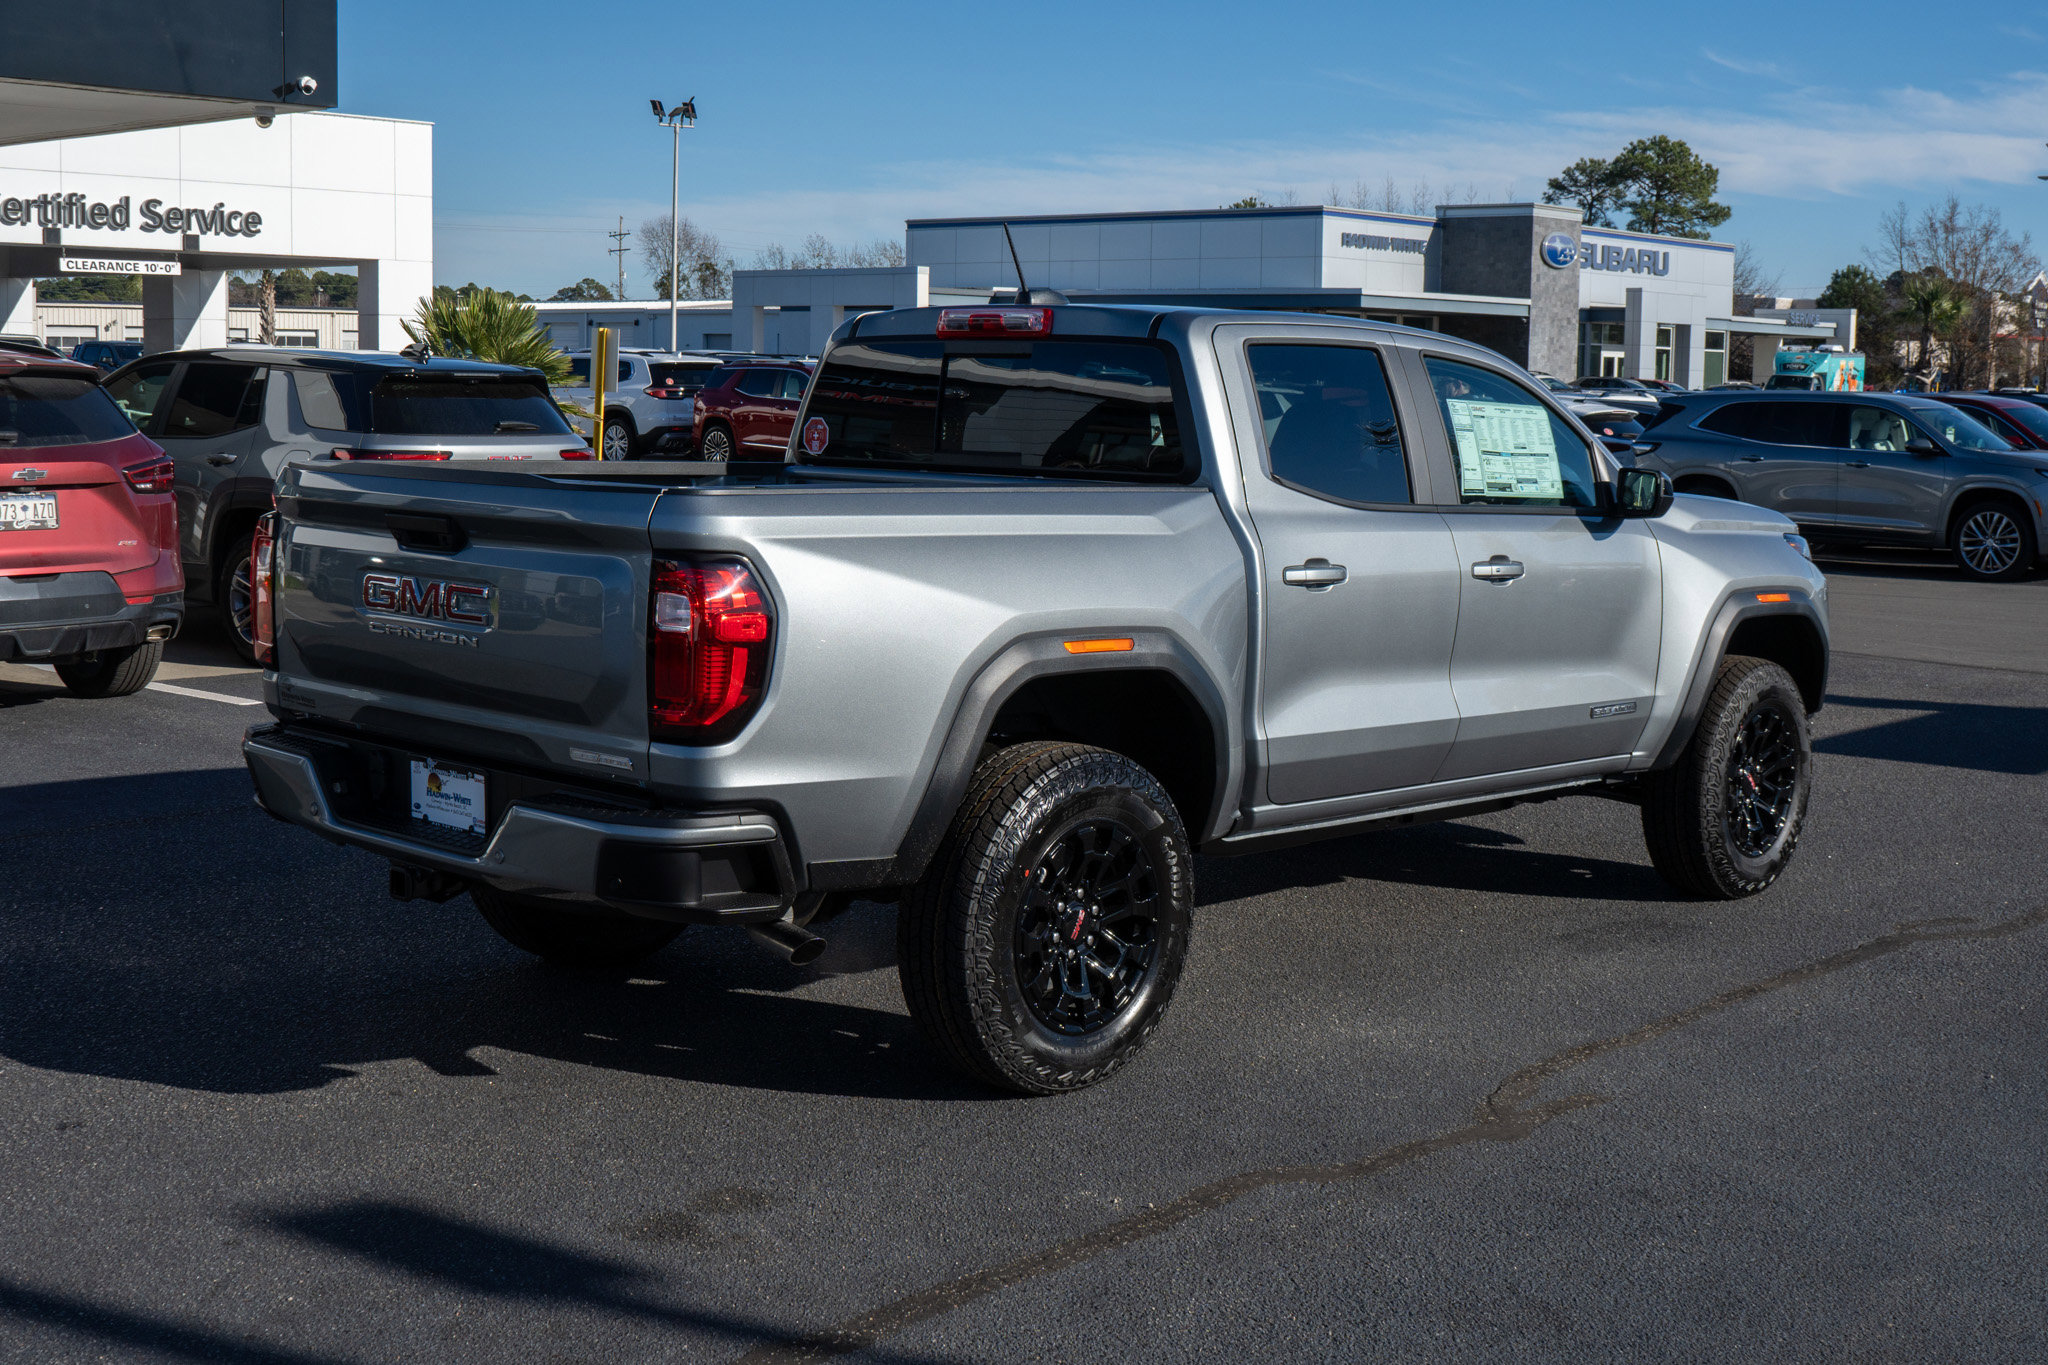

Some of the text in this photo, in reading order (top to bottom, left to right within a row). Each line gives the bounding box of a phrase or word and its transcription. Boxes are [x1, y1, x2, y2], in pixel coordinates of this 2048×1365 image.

[0, 192, 262, 237] ertified Service
[66, 260, 140, 273] CLEARANCE
[1579, 242, 1670, 276] SUBARU
[1789, 311, 1821, 325] SERVICE
[0, 503, 17, 521] 73
[362, 573, 490, 627] GMC
[368, 621, 480, 648] CANYON
[426, 787, 472, 806] HADWIN-WHITE
